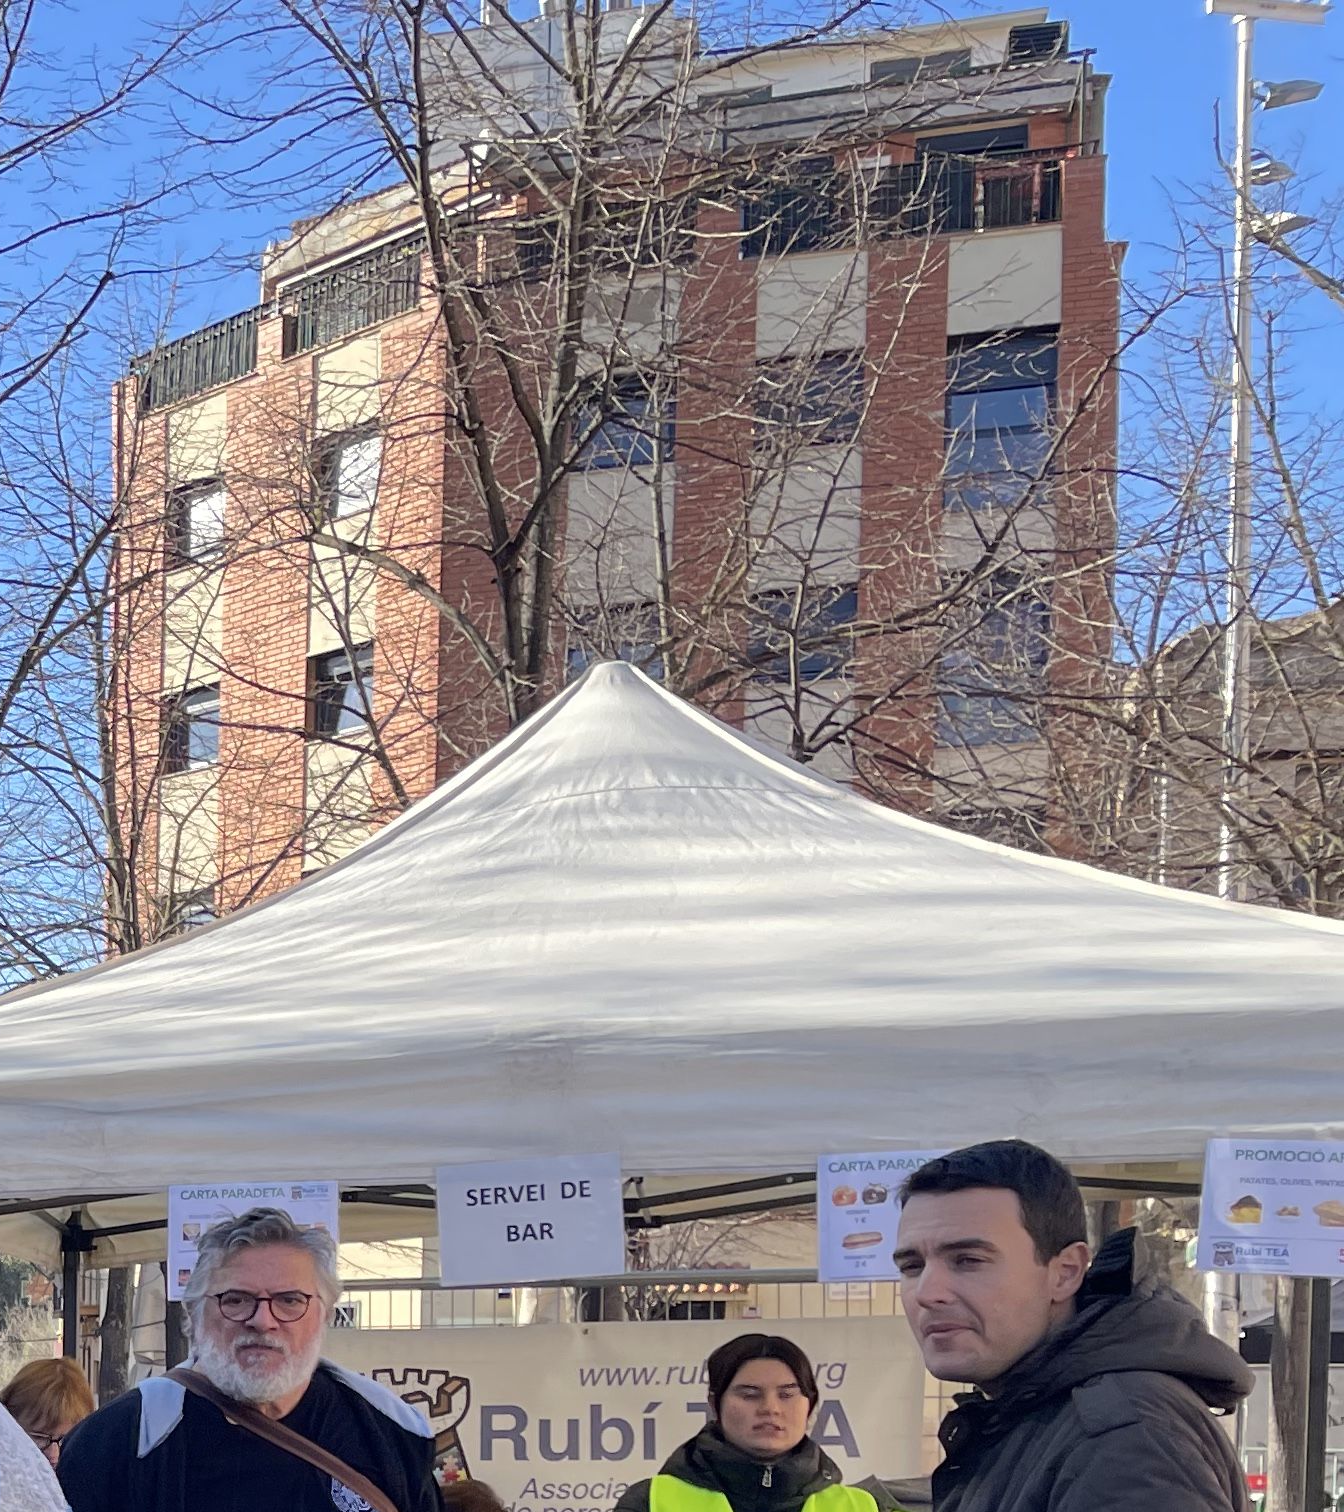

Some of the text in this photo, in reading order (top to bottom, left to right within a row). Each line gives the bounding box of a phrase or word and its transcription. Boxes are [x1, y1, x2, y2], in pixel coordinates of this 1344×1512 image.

[1235, 1148, 1325, 1162] PROMOCIÓ
[828, 1161, 874, 1173] CARTA
[180, 1187, 285, 1200] CARTA PARADETA
[466, 1180, 591, 1207] SERVEI DE
[507, 1222, 554, 1242] BAR
[1265, 1247, 1290, 1257] TEA
[480, 1401, 662, 1461] Rubí
